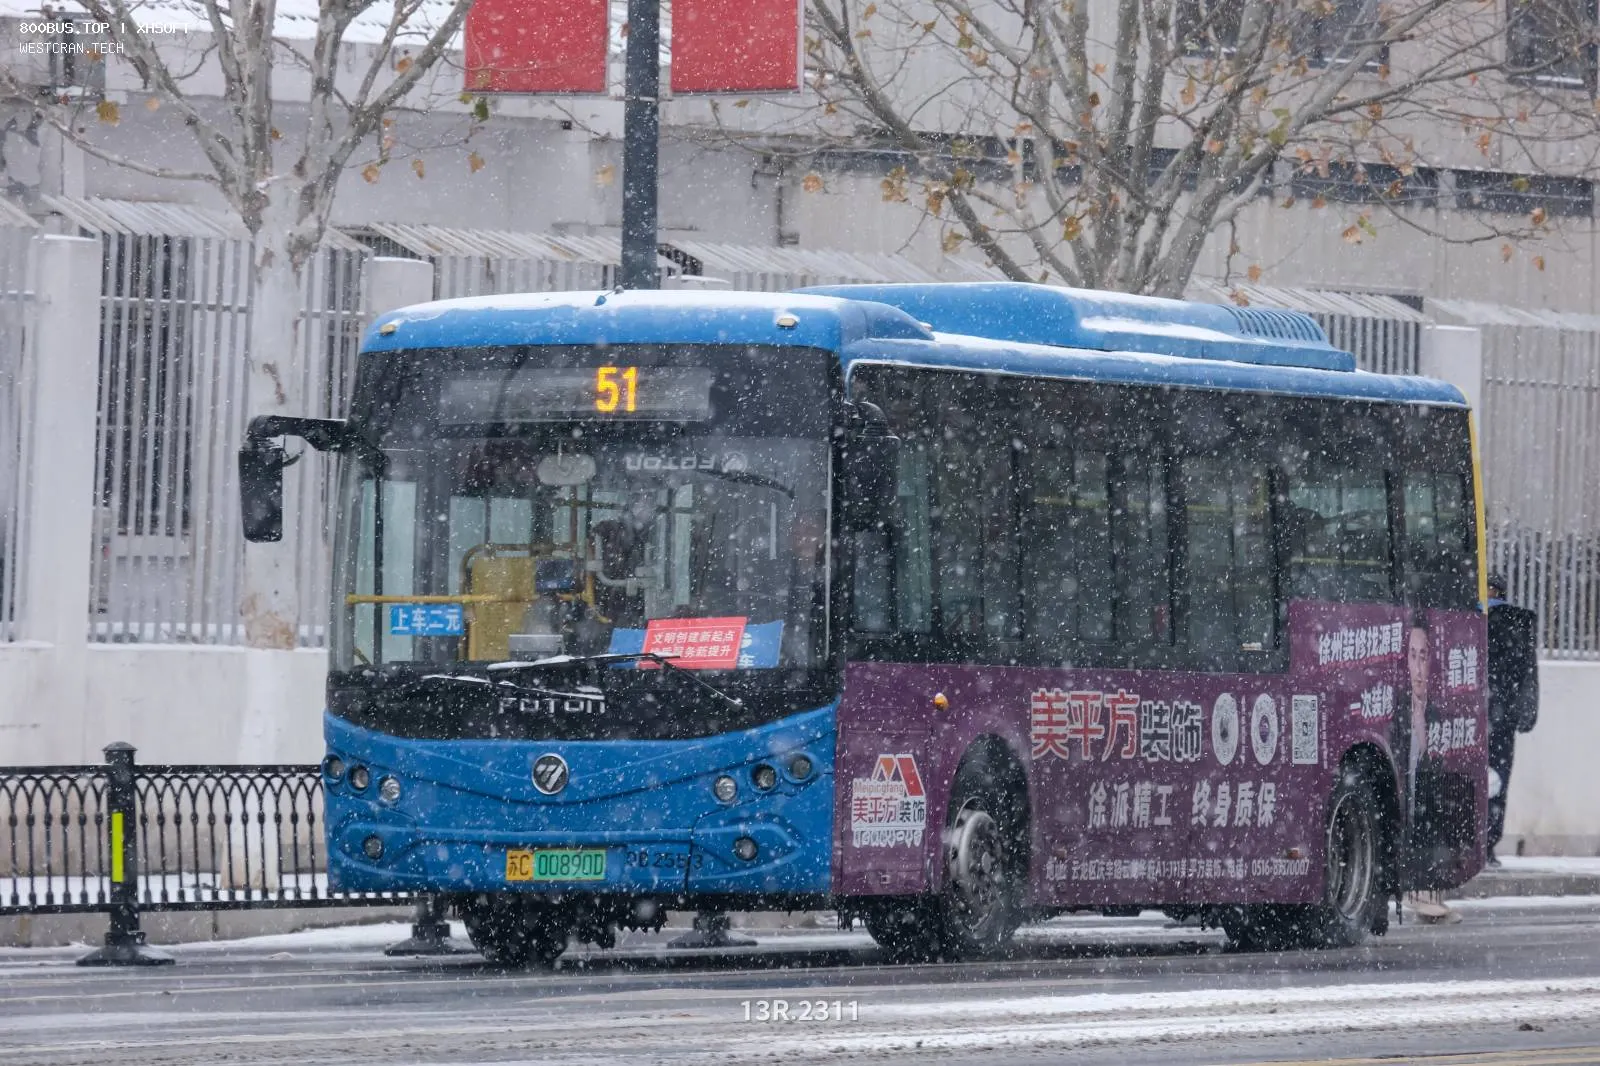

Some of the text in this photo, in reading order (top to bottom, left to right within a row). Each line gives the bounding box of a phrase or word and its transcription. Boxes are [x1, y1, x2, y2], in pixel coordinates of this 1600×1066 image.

[596, 366, 638, 412] 51
[391, 607, 461, 632] 上车二元
[652, 630, 735, 645] 文明创建新起点
[1448, 646, 1478, 689] 靠谱
[1350, 684, 1394, 719] 一次装修
[1031, 688, 1202, 762] 美平方装饰
[1428, 716, 1477, 754] 终身朋友
[853, 796, 925, 823] 美平方装饰
[1088, 780, 1276, 829] 徐派精工 终身质保
